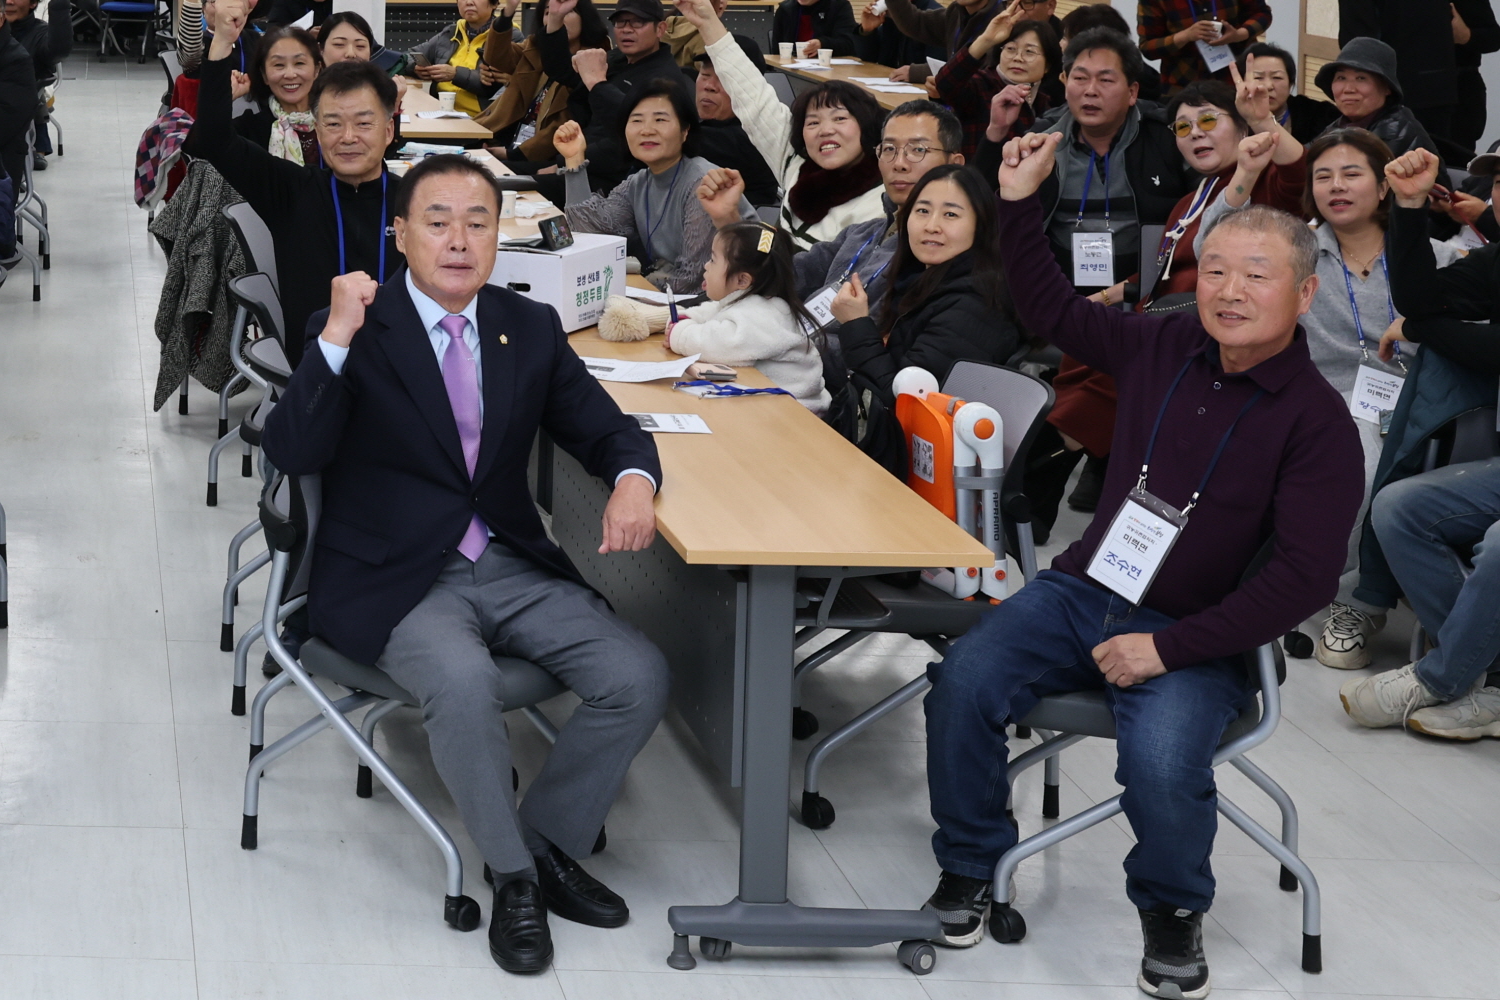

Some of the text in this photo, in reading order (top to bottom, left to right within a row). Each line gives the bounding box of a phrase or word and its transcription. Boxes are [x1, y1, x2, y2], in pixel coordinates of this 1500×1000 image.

[1079, 263, 1108, 272] 최영민
[575, 286, 602, 307] 청정두릅
[992, 491, 1000, 542] APRAMO
[1122, 533, 1149, 554] 미력면
[1103, 550, 1142, 581] 조수현
